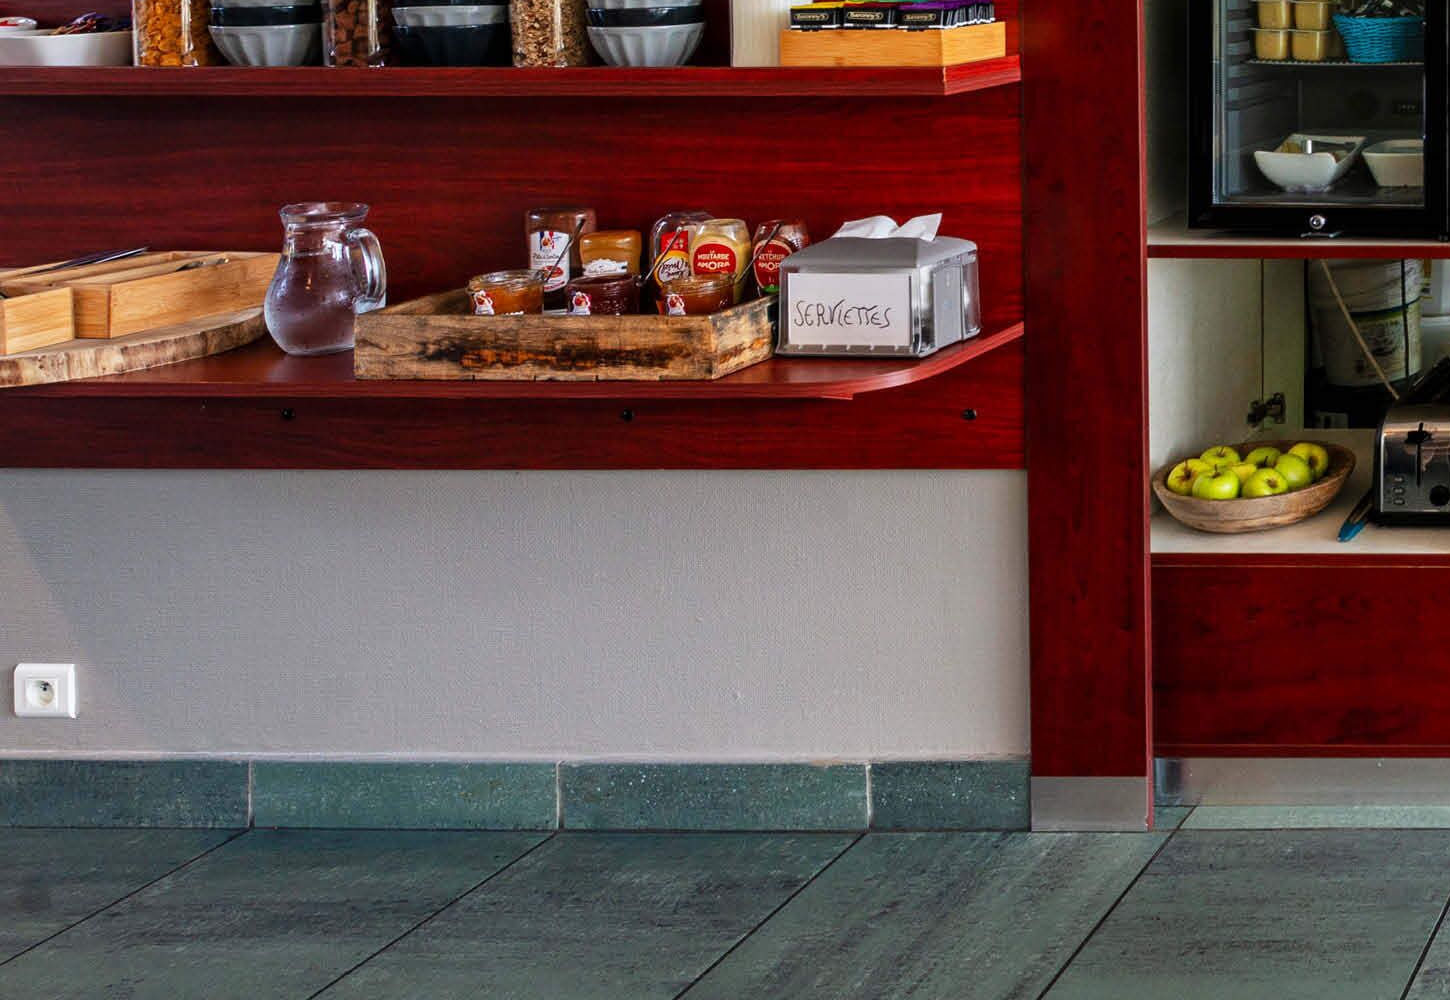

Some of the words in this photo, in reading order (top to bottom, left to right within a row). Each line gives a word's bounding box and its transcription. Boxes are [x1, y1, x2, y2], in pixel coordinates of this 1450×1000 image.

[696, 261, 731, 270] AMORA
[758, 261, 780, 271] AMOR
[793, 298, 895, 329] SERVIETTES
